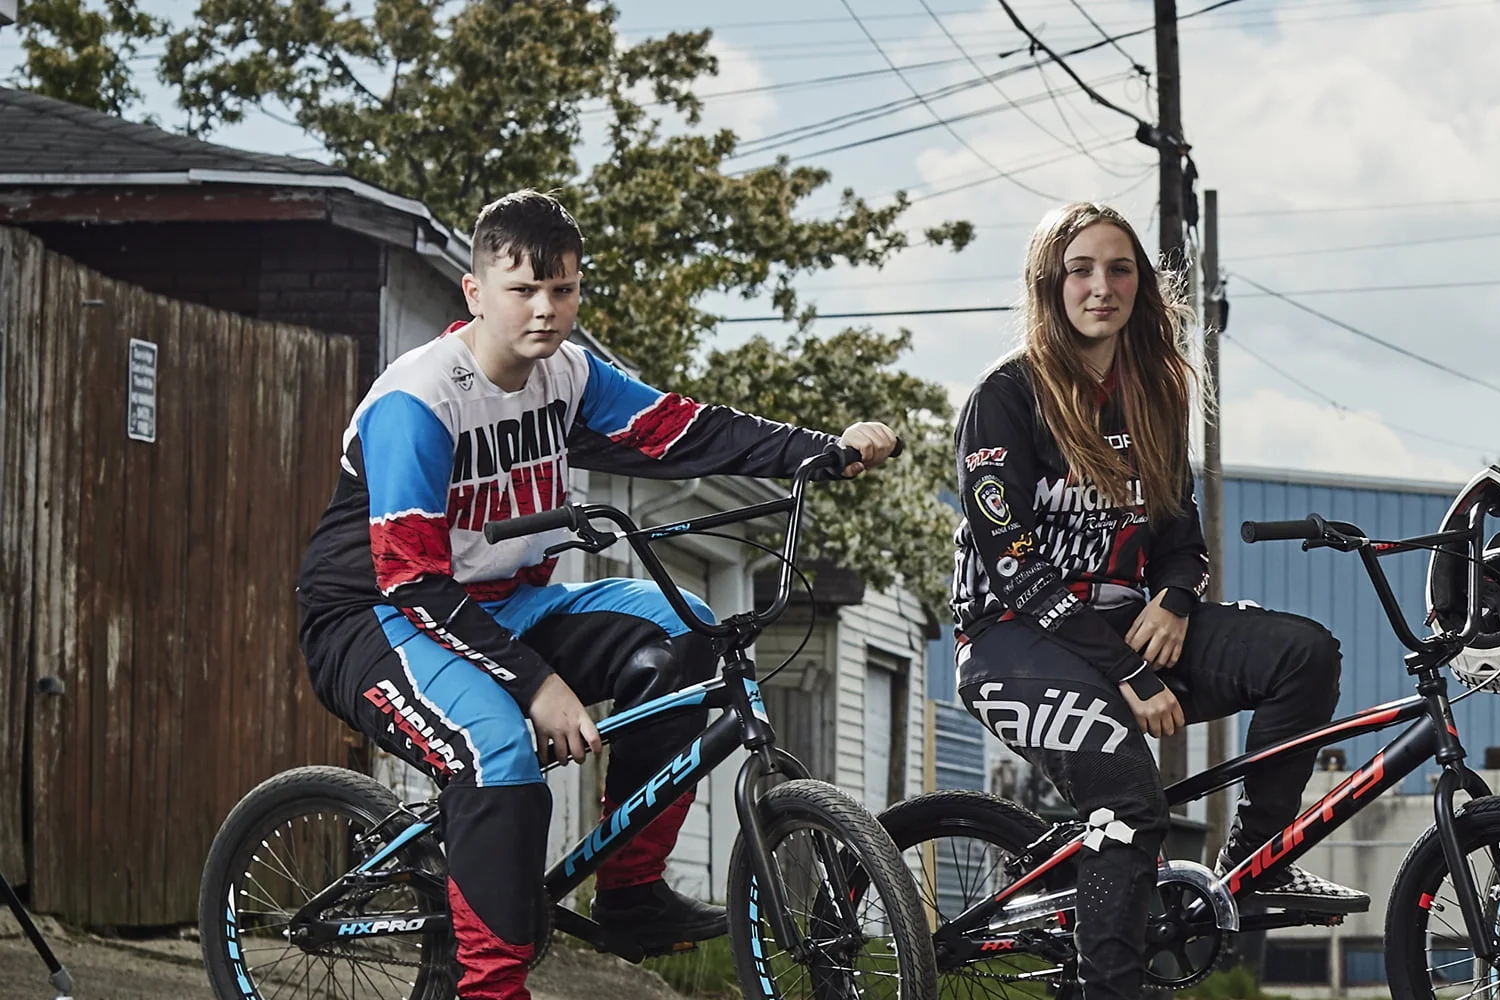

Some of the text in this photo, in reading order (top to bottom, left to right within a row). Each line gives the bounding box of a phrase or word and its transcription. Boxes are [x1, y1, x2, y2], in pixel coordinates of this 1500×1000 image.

[1038, 592, 1079, 629] BIKE
[973, 682, 1128, 754] faith
[564, 737, 702, 878] HUFFY
[1229, 752, 1384, 895] HUFFY
